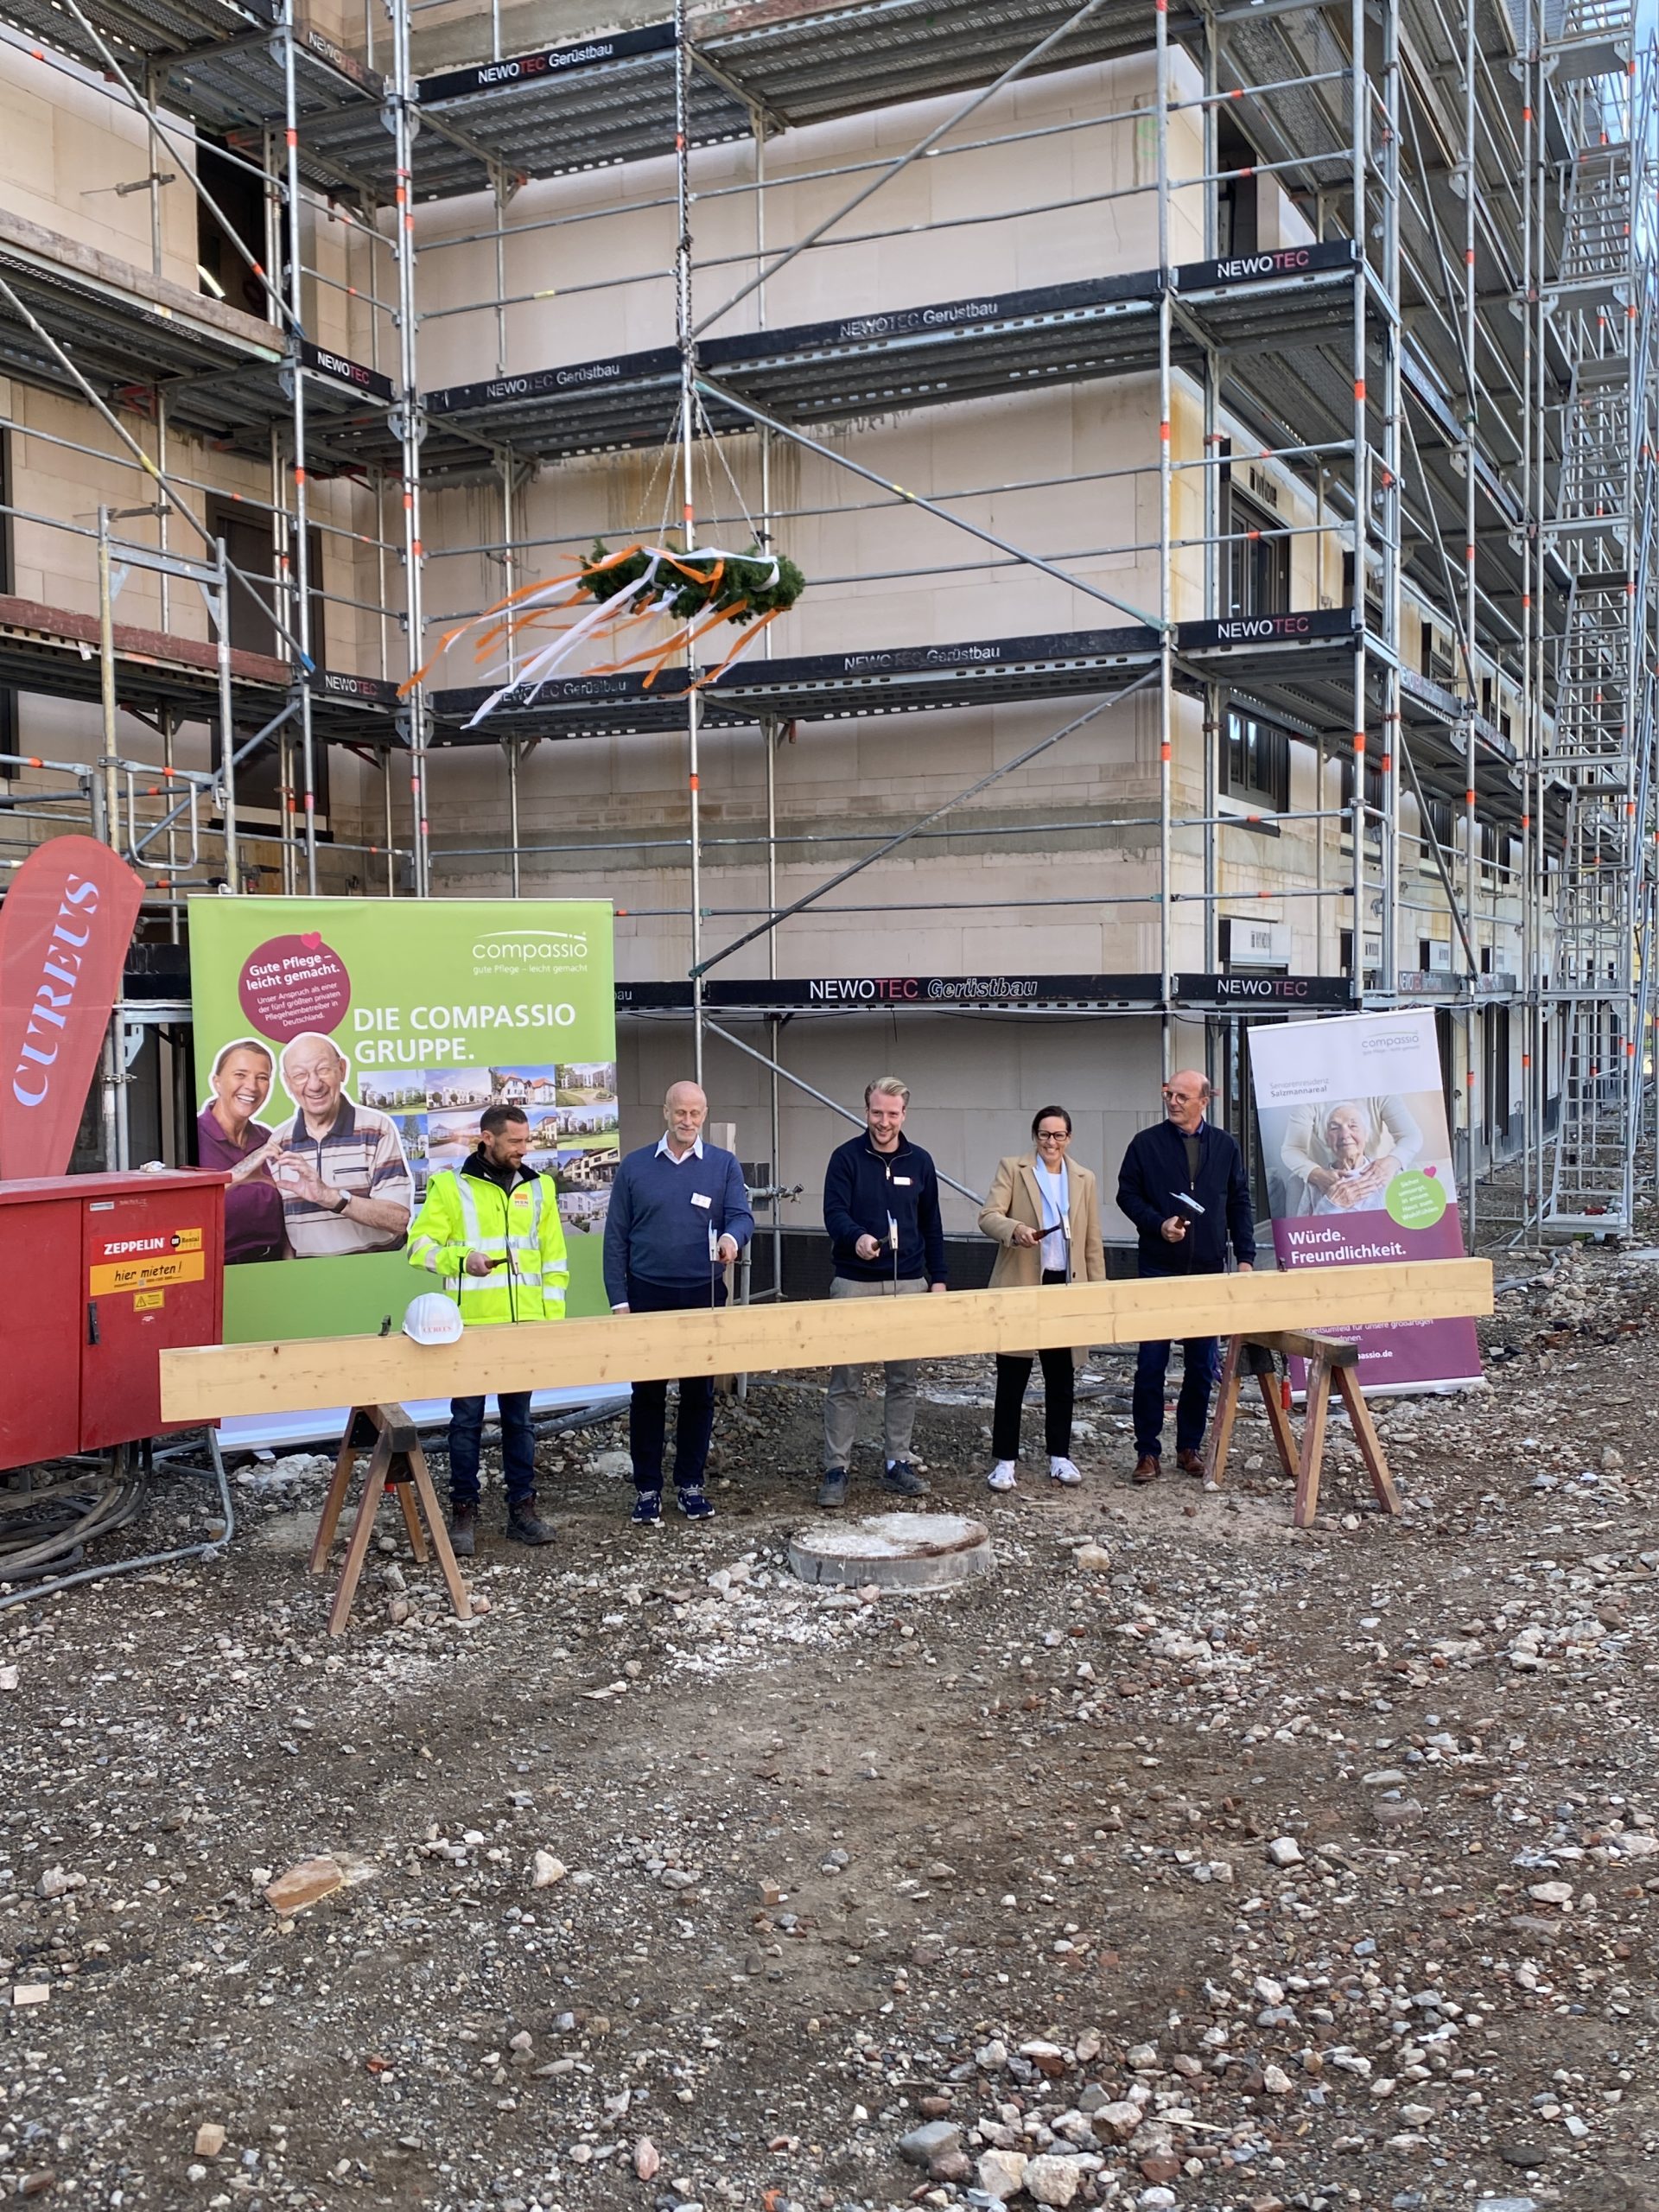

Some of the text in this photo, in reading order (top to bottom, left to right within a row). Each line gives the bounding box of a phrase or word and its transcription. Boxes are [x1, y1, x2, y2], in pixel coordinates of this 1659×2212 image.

[478, 43, 613, 84] NEWOTEC Gerüstbau
[1217, 251, 1310, 278] NEWOTEC
[317, 351, 371, 385] NEWOTEC
[556, 364, 620, 385] Gerüstbau
[1217, 617, 1309, 639] NEWOTEC
[325, 675, 377, 696] NEWOTEC
[472, 942, 588, 963] compassio
[249, 963, 281, 976] Gute
[283, 954, 322, 970] Pflege
[473, 965, 493, 976] gute
[494, 964, 519, 975] Pflege
[553, 963, 588, 975] gemacht
[246, 963, 340, 991] leicht gemacht.
[810, 977, 1038, 999] NEWOTEC Gerüstbau
[1217, 979, 1308, 996] NEWOTEC
[13, 873, 99, 1107] CUREUS
[257, 995, 277, 1005] Unser
[278, 987, 310, 1001] Anspruch
[321, 982, 338, 992] einer
[258, 1005, 270, 1014] der
[314, 991, 340, 1003] privaten
[282, 1012, 326, 1027] Deutschland.
[353, 1003, 576, 1032] DIE COMPASSIO
[354, 1037, 474, 1064] GRUPPE.
[1362, 1035, 1419, 1048] compassio
[104, 1237, 165, 1255] ZEPPELIN
[1287, 1229, 1345, 1245] Würde.
[1291, 1242, 1407, 1264] Freundlichkeit.
[114, 1270, 137, 1281] hier
